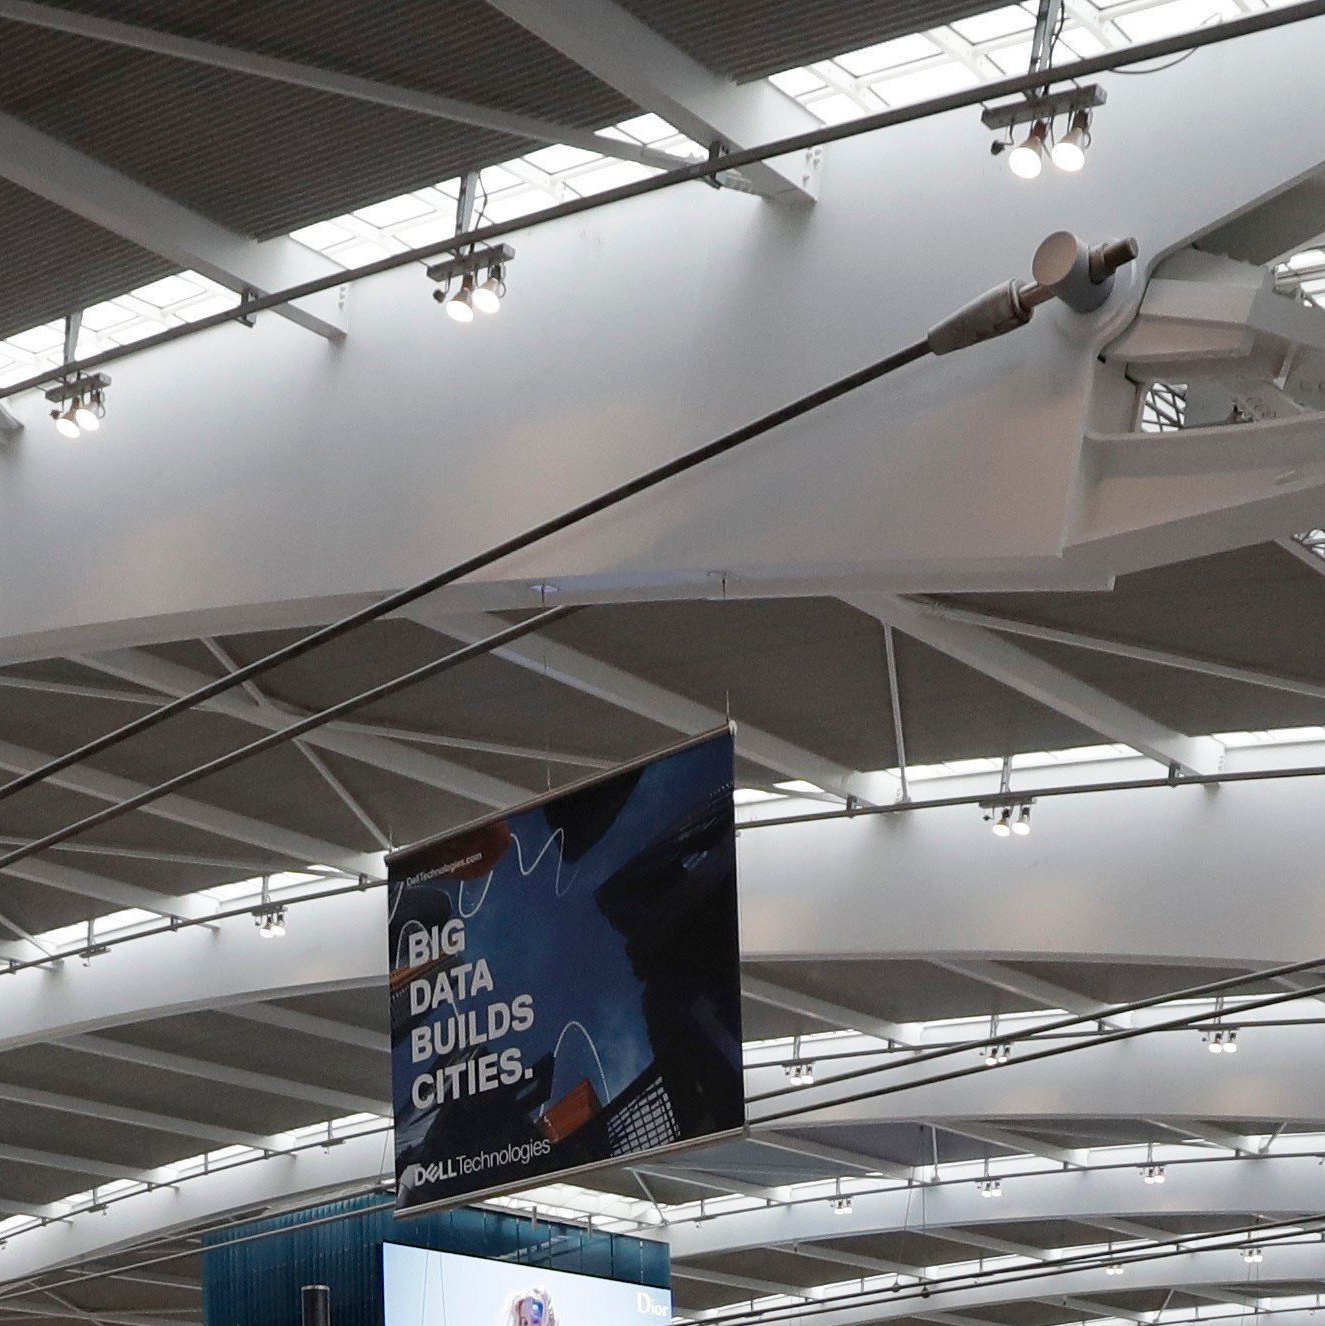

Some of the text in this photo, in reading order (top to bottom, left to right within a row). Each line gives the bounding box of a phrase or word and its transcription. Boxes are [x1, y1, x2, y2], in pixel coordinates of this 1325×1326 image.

[406, 853, 483, 887] DellTechnologies.com
[408, 918, 466, 969] BIG
[410, 958, 494, 1016] DATA
[411, 994, 535, 1063] BUILDS
[412, 1047, 534, 1110] CITIES.
[414, 1138, 551, 1186] DELL Technologies
[635, 1291, 669, 1316] Dior
